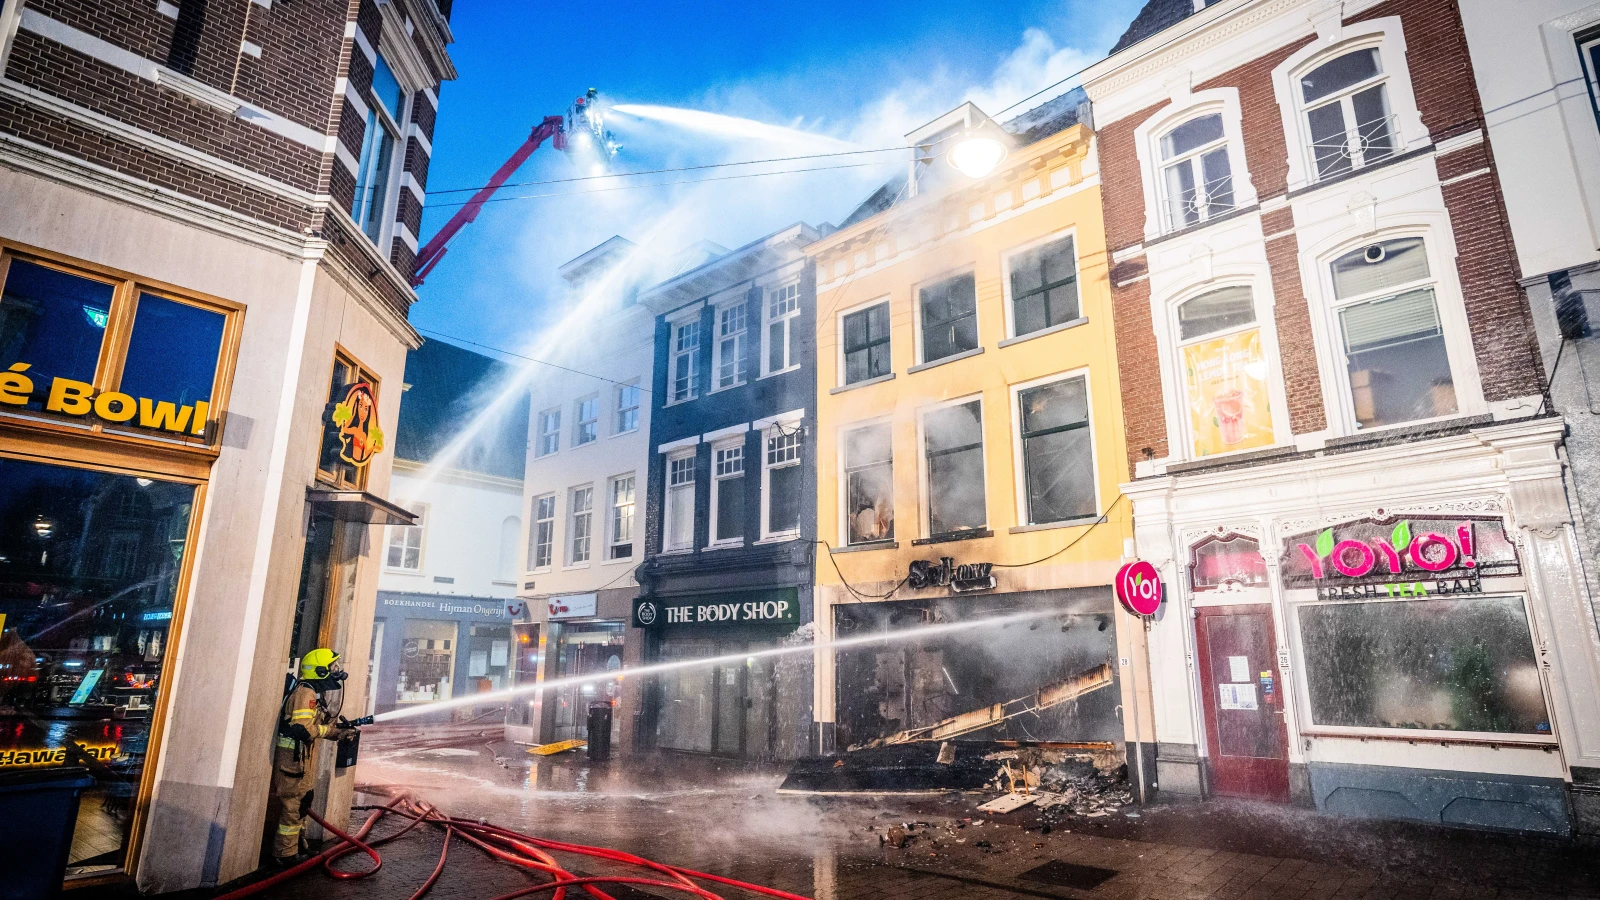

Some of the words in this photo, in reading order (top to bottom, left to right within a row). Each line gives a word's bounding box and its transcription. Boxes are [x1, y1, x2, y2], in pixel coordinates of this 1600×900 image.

[1198, 367, 1228, 383] LEMO
[46, 376, 210, 435] Bowl
[1318, 584, 1377, 600] FRESH
[1384, 582, 1428, 597] TEA
[1436, 578, 1481, 595] BAR
[384, 599, 436, 608] BOEKHANDEL
[439, 602, 472, 614] Hijman
[665, 606, 693, 623] THE
[697, 603, 741, 622] BODY
[1281, 656, 1288, 664] 26
[0, 743, 118, 766] Hawaan
